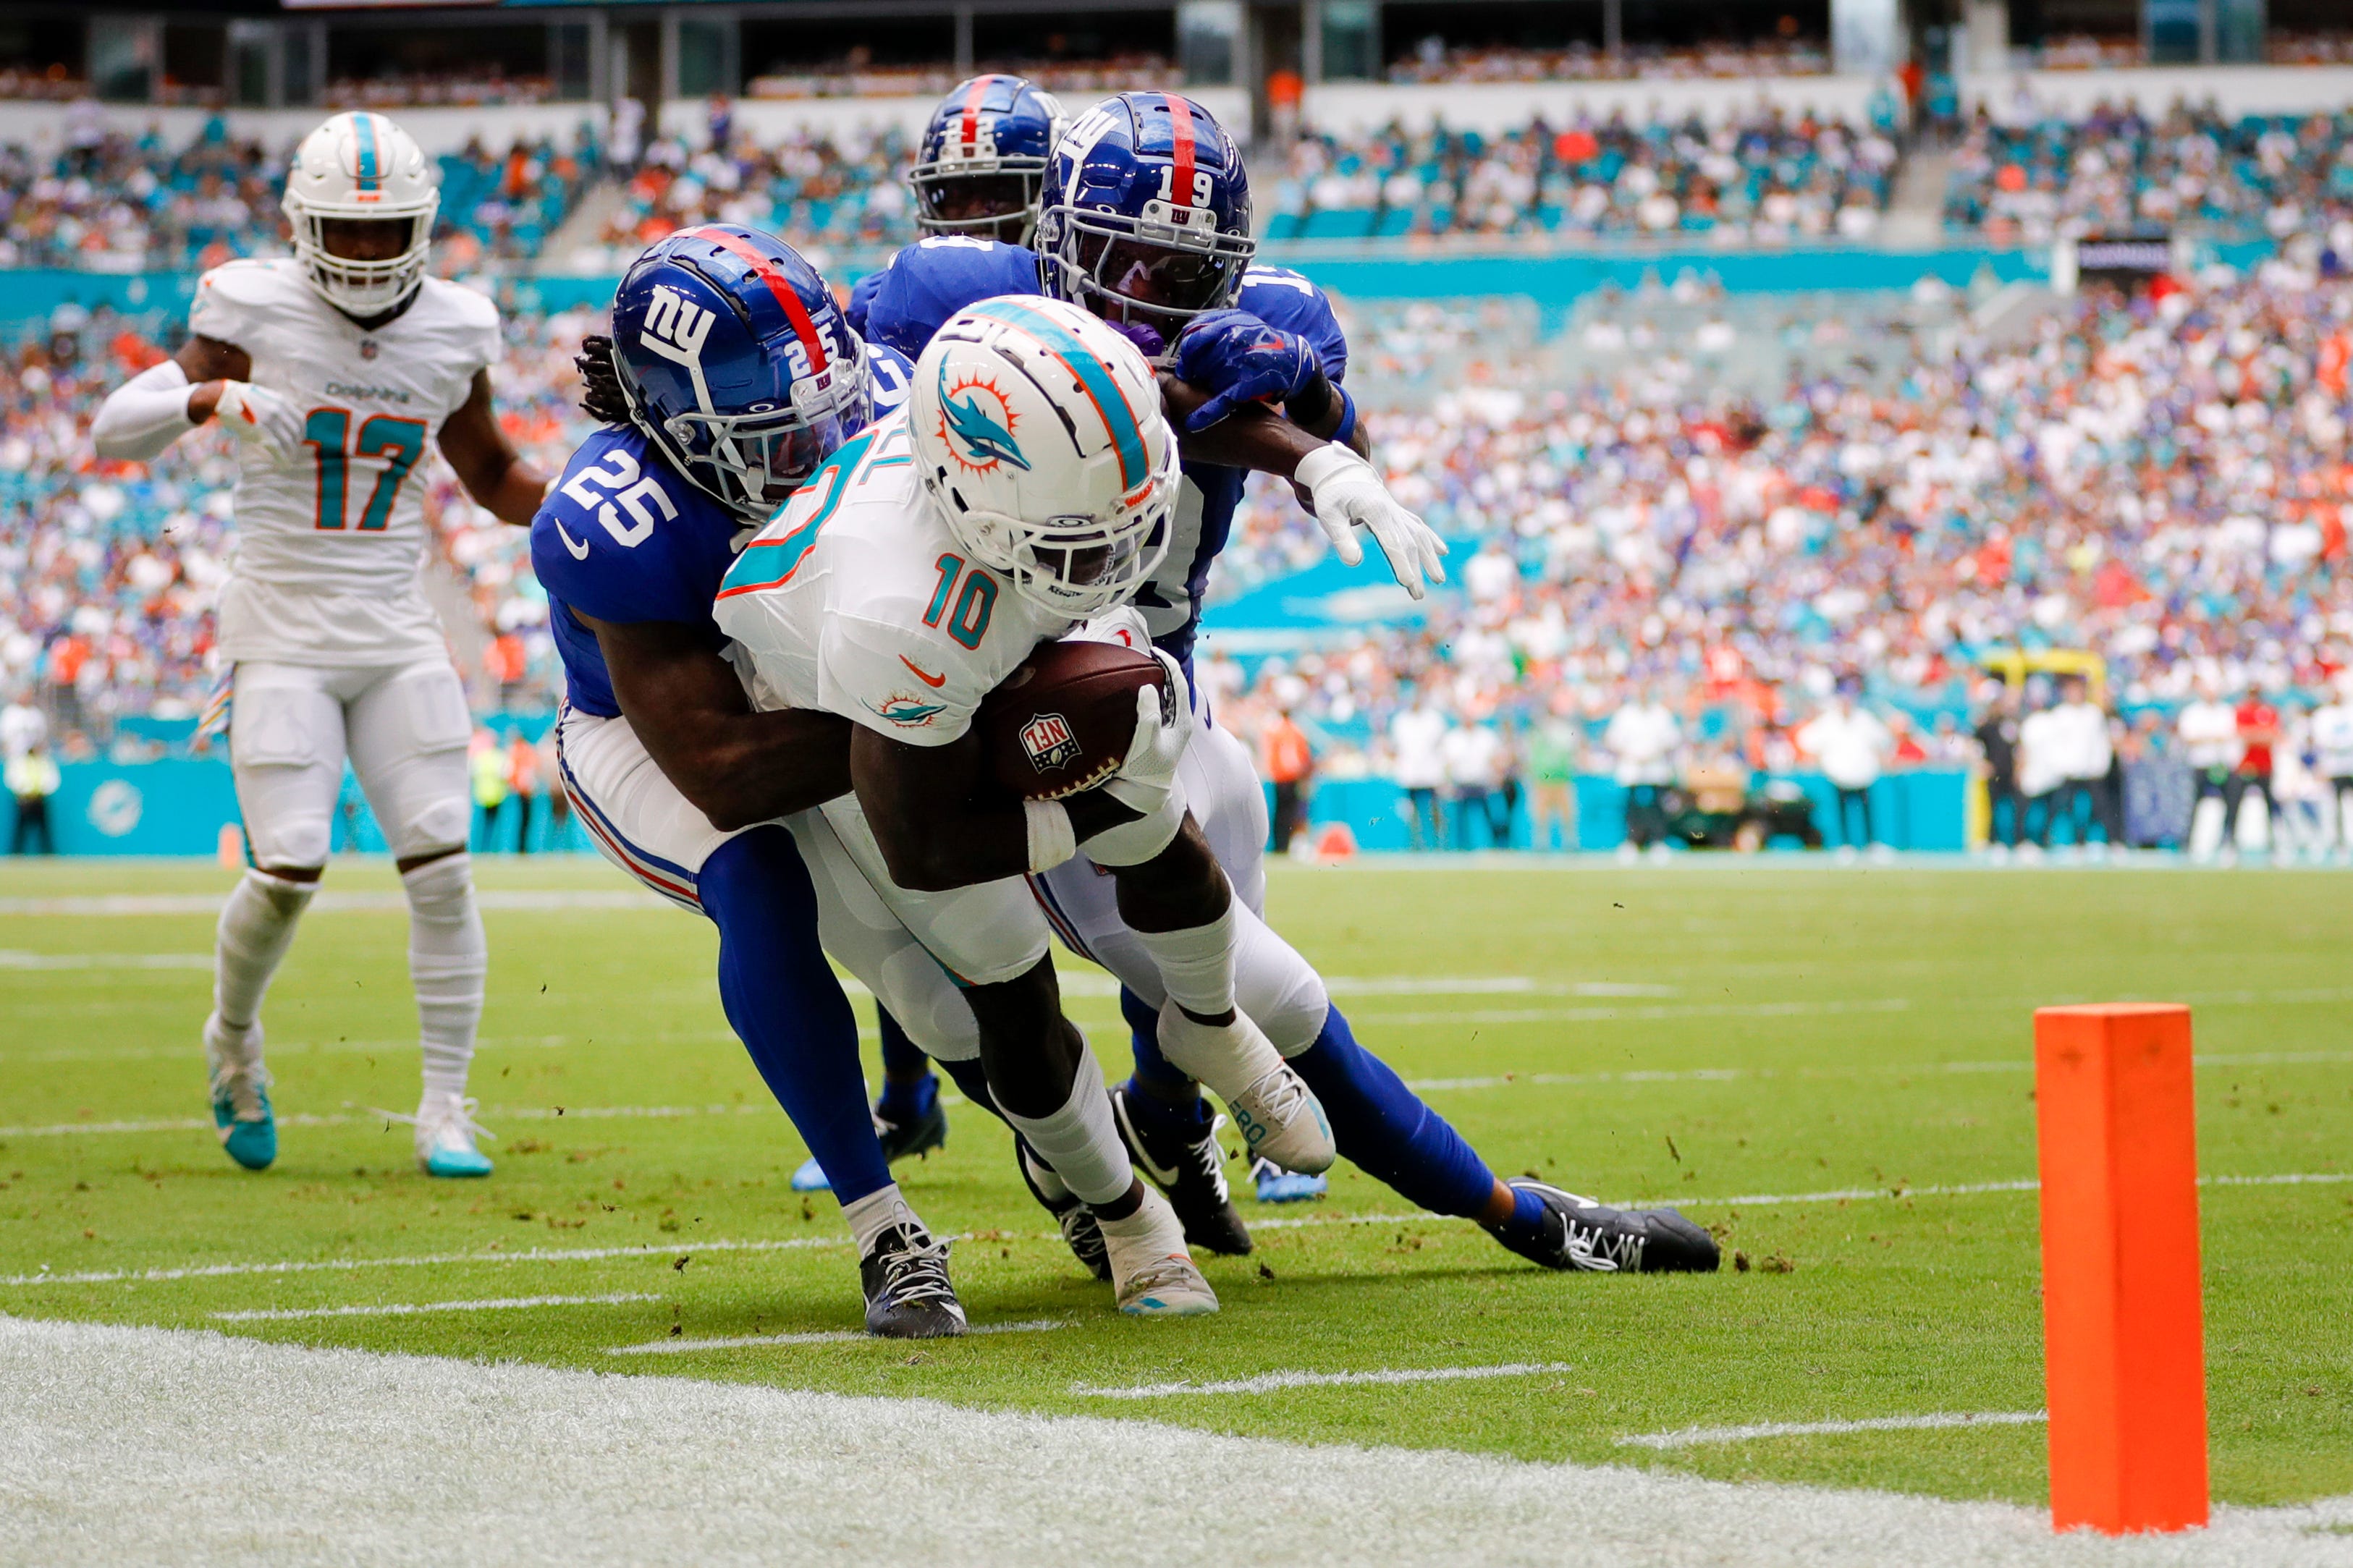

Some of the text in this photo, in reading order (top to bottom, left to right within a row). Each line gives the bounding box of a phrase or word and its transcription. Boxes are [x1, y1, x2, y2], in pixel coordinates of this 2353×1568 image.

[1157, 165, 1213, 208] 19
[784, 321, 840, 381] 25
[301, 406, 428, 531] 17
[560, 449, 679, 548] 25
[921, 552, 999, 650] 10
[1024, 719, 1069, 753] NFL
